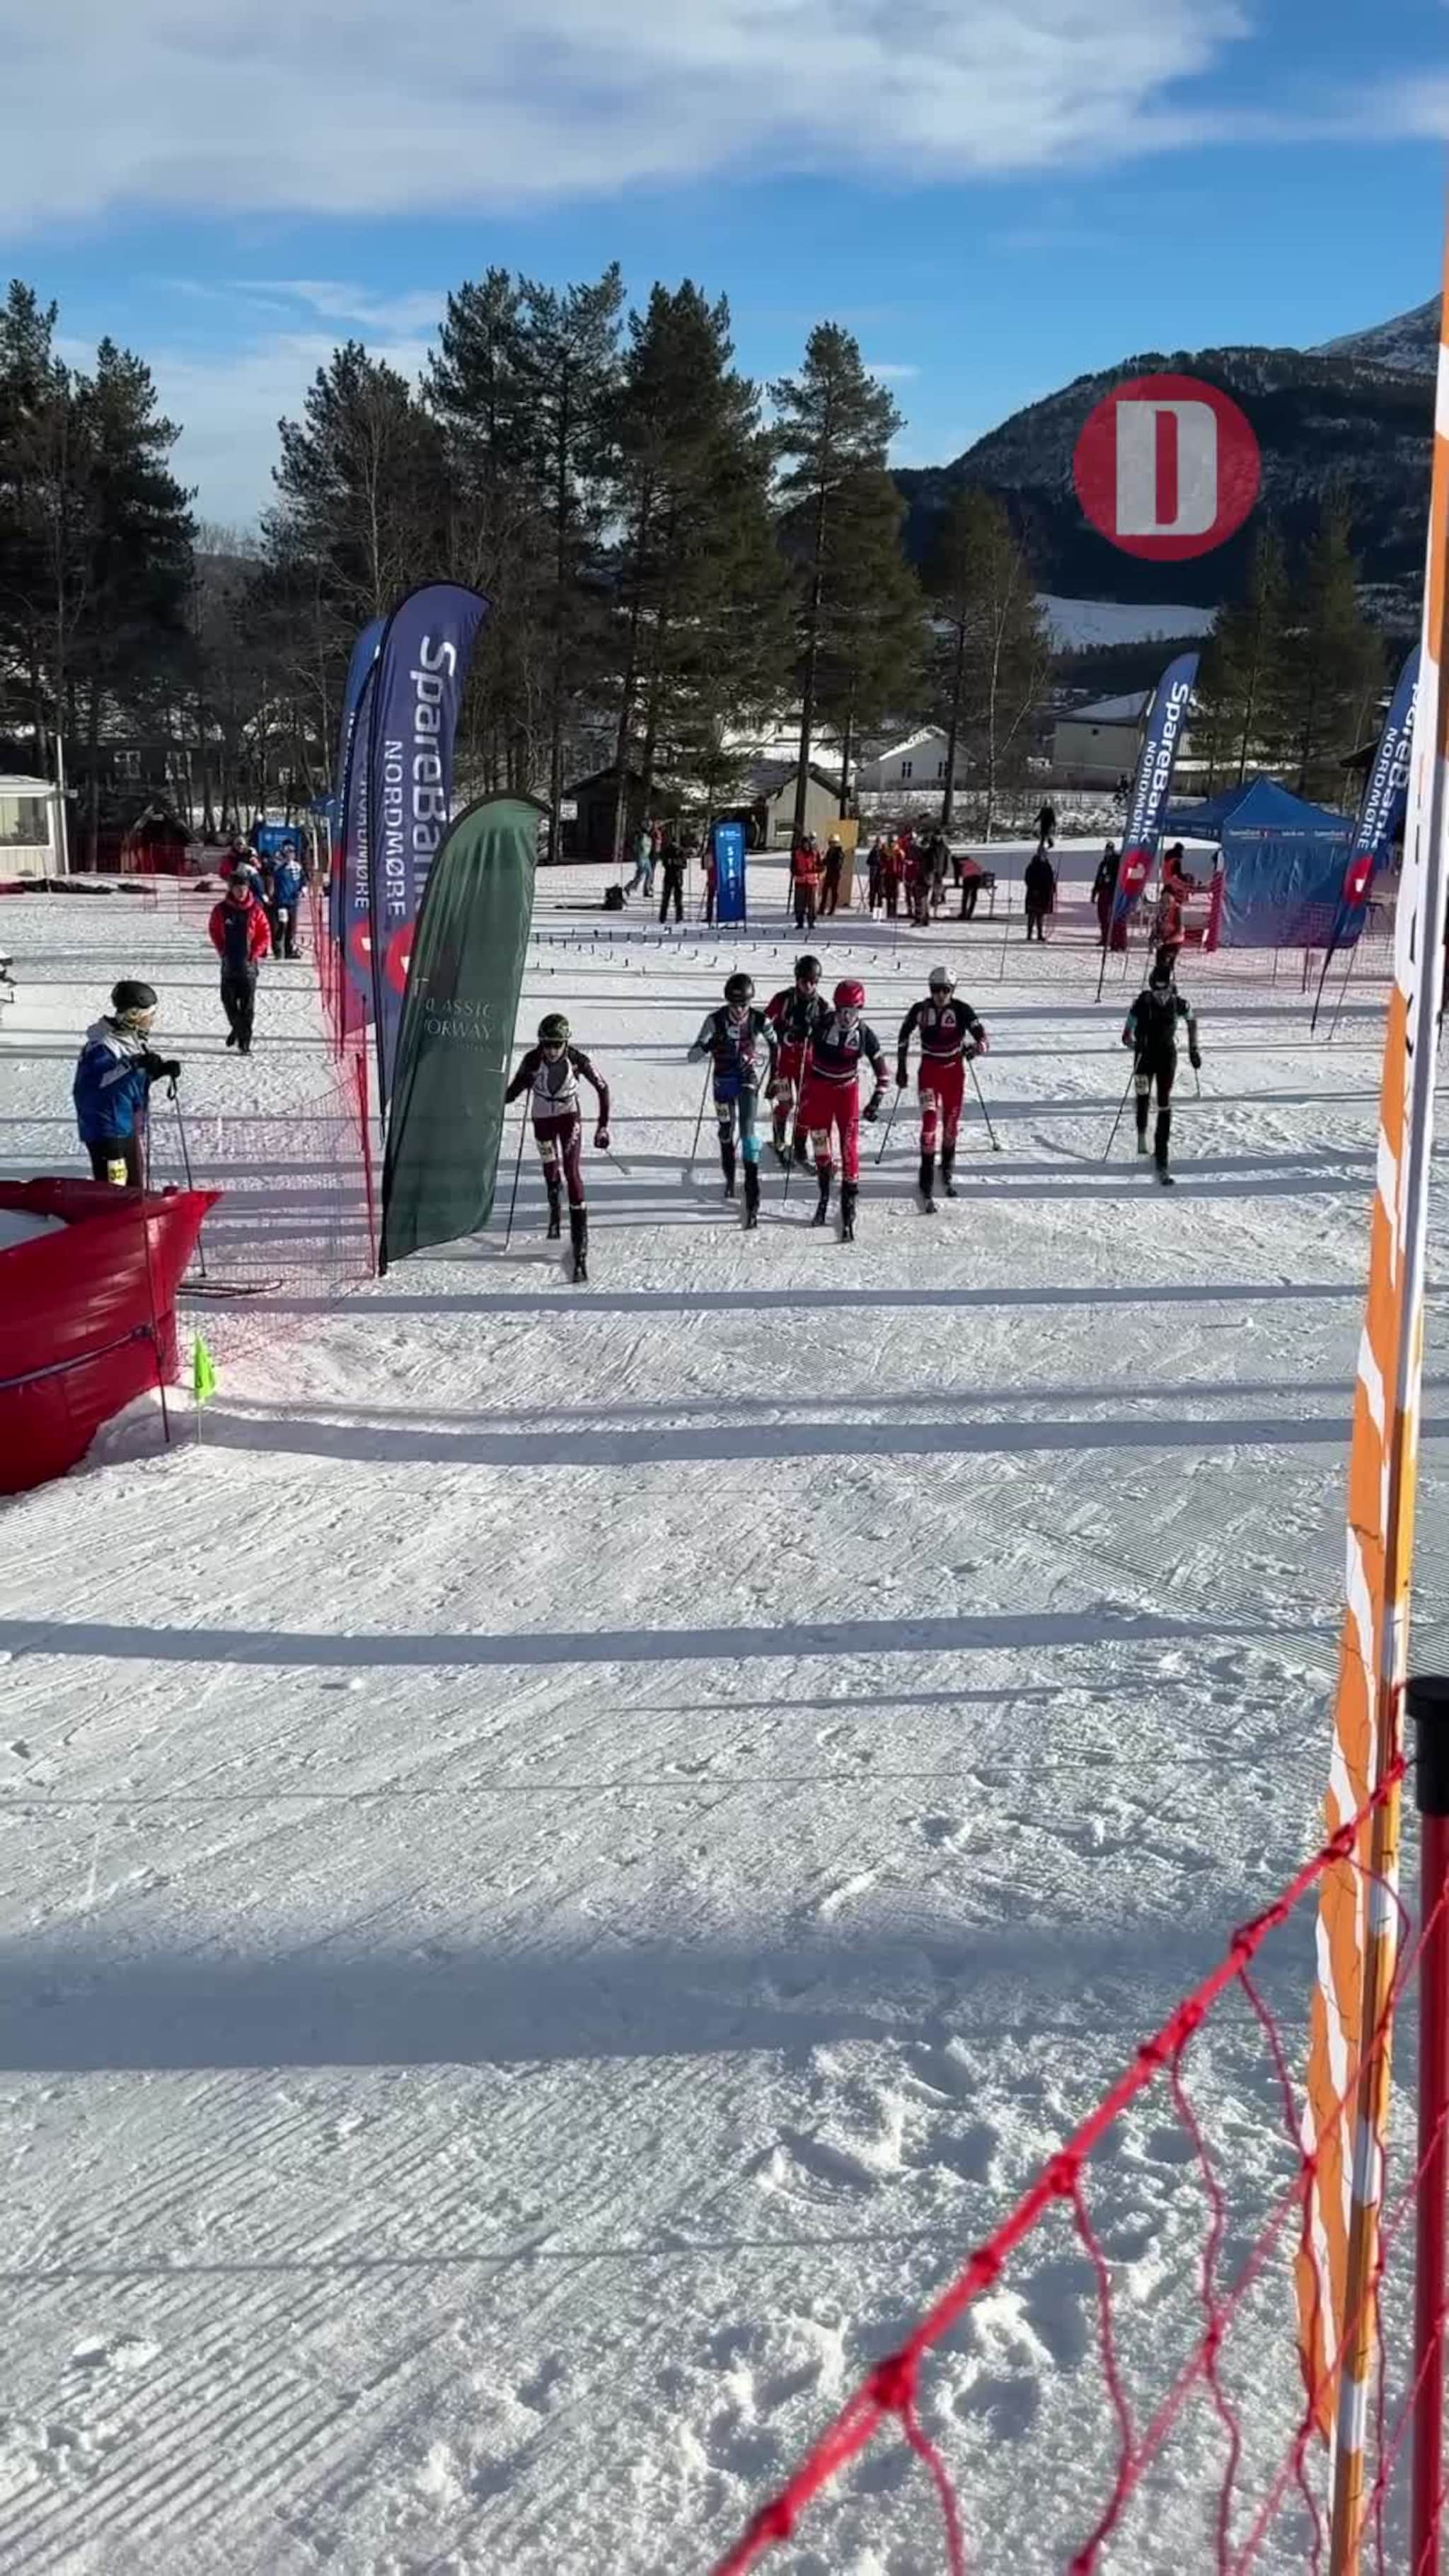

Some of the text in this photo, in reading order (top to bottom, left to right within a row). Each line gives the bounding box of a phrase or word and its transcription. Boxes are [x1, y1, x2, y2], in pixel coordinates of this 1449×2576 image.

[384, 740, 407, 916] NORDMØRE
[410, 635, 457, 911] SpareBan
[1129, 741, 1158, 845] NORDMØRE
[1140, 681, 1189, 844] SpareBank
